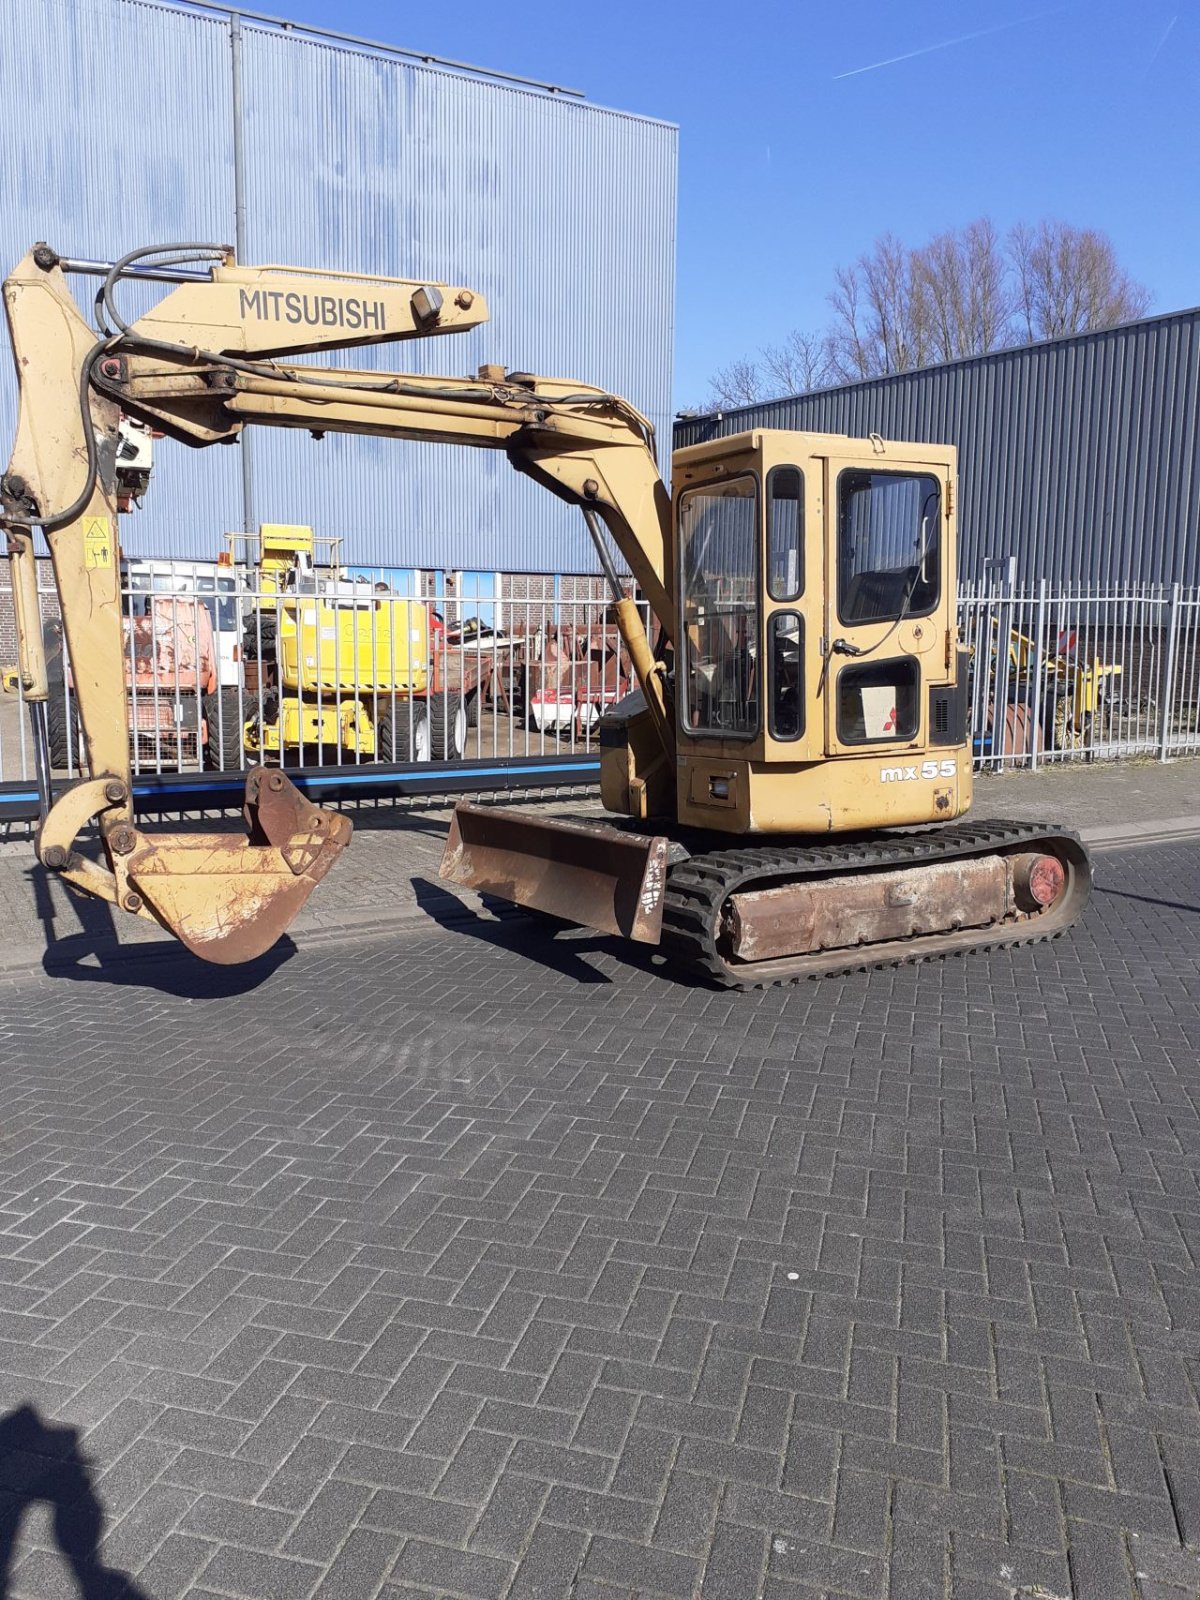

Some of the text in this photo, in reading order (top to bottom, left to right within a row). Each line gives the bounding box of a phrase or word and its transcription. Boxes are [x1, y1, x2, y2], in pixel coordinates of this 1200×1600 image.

[240, 289, 386, 330] MITSUBISHI
[880, 759, 957, 783] mx 55
